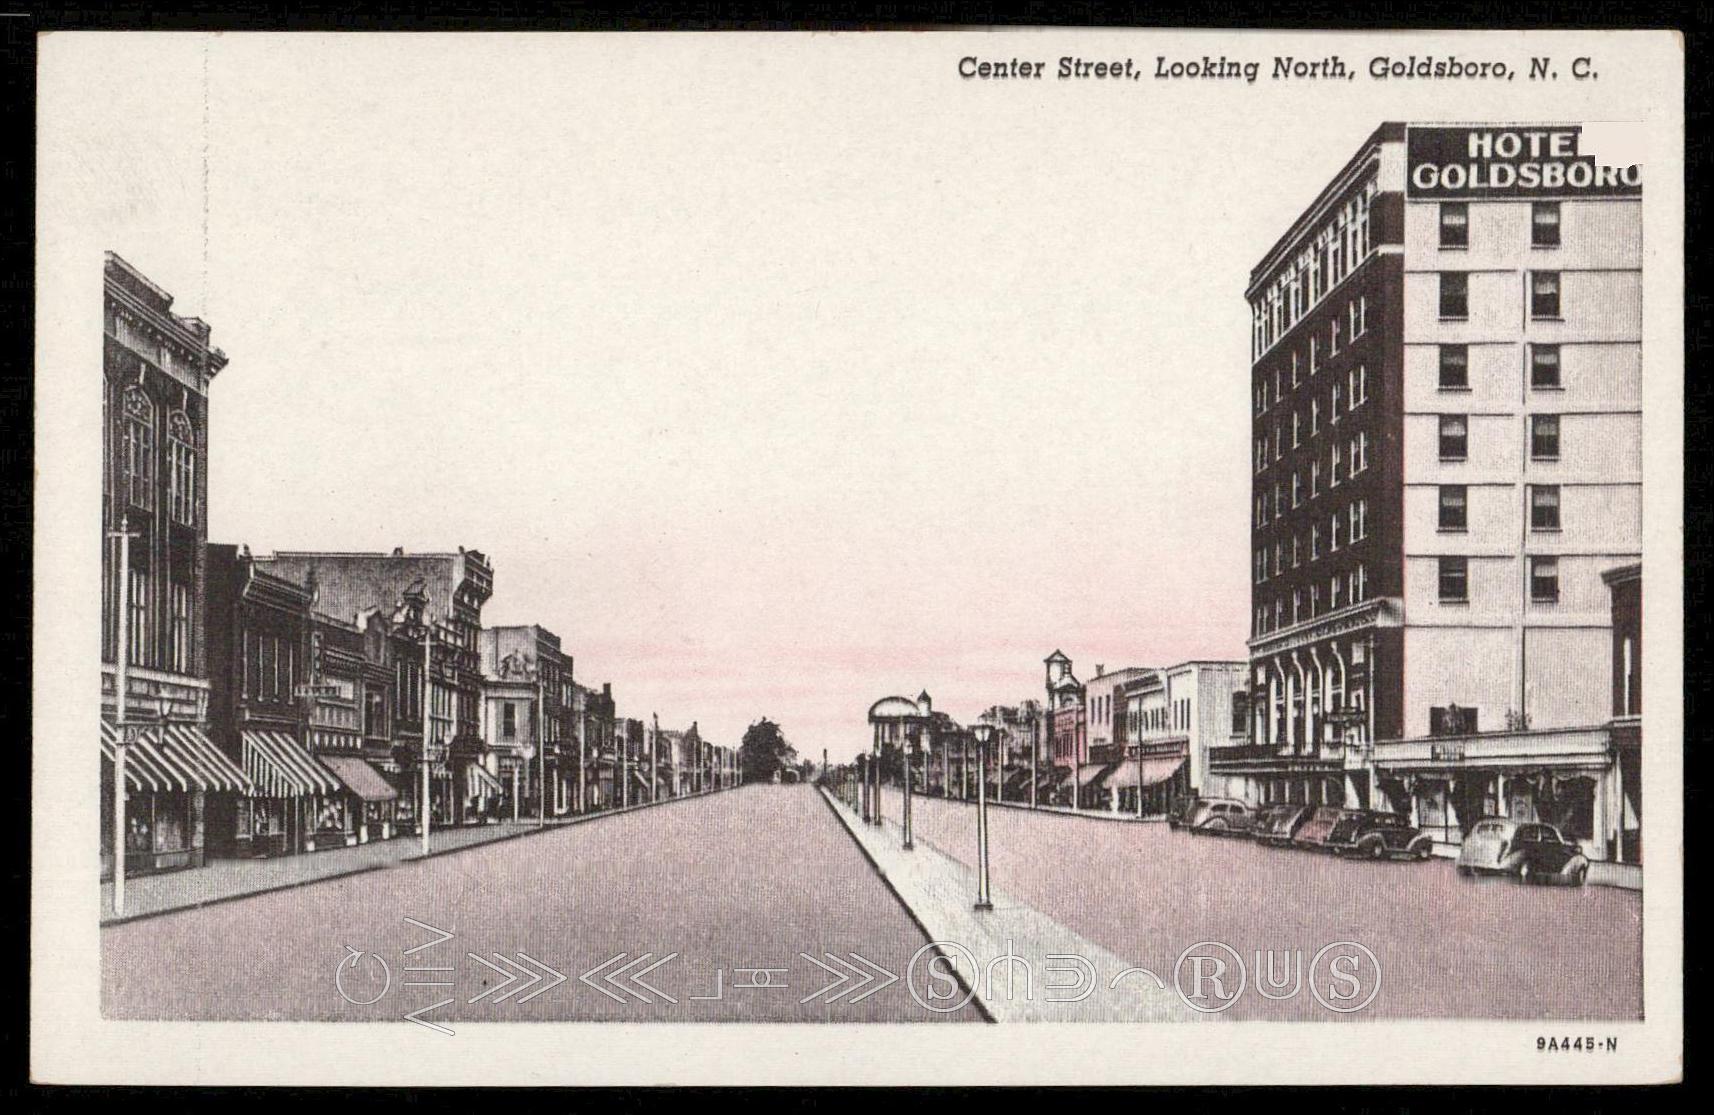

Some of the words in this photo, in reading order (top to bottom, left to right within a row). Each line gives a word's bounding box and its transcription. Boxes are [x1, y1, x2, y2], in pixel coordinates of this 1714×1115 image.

[958, 55, 1046, 79] Center
[1057, 55, 1141, 81] Street,
[1154, 55, 1260, 84] Looking
[1272, 55, 1355, 81] North,
[1369, 55, 1515, 81] Goldsboro,
[1529, 56, 1558, 80] N.
[1571, 56, 1599, 80] C.
[1412, 162, 1643, 189] GOLDSBORO
[1536, 1036, 1618, 1051] 9A445-N
